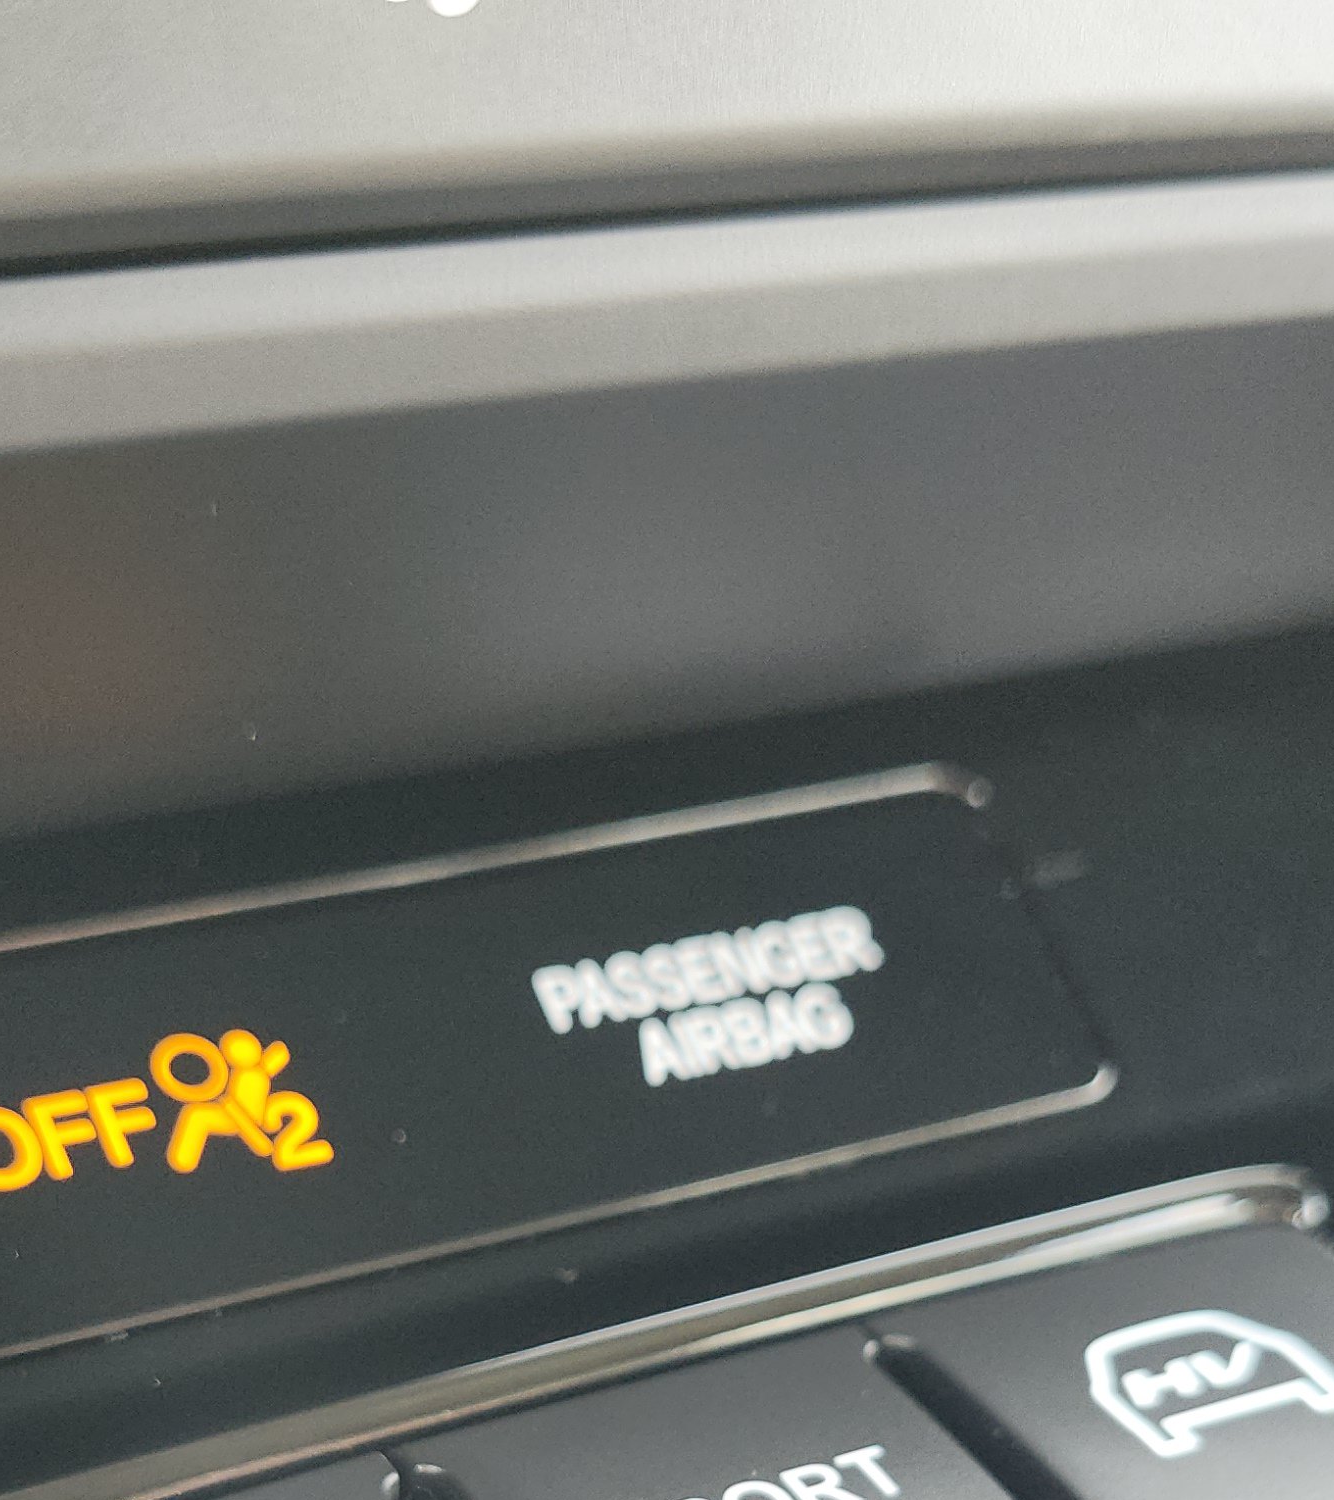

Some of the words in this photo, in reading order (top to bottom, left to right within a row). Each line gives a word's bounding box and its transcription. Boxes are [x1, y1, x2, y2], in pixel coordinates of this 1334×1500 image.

[532, 905, 885, 1034] PASSENGER
[639, 983, 856, 1088] AIRBAG
[265, 1090, 335, 1172] 2
[1121, 1337, 1261, 1407] HV
